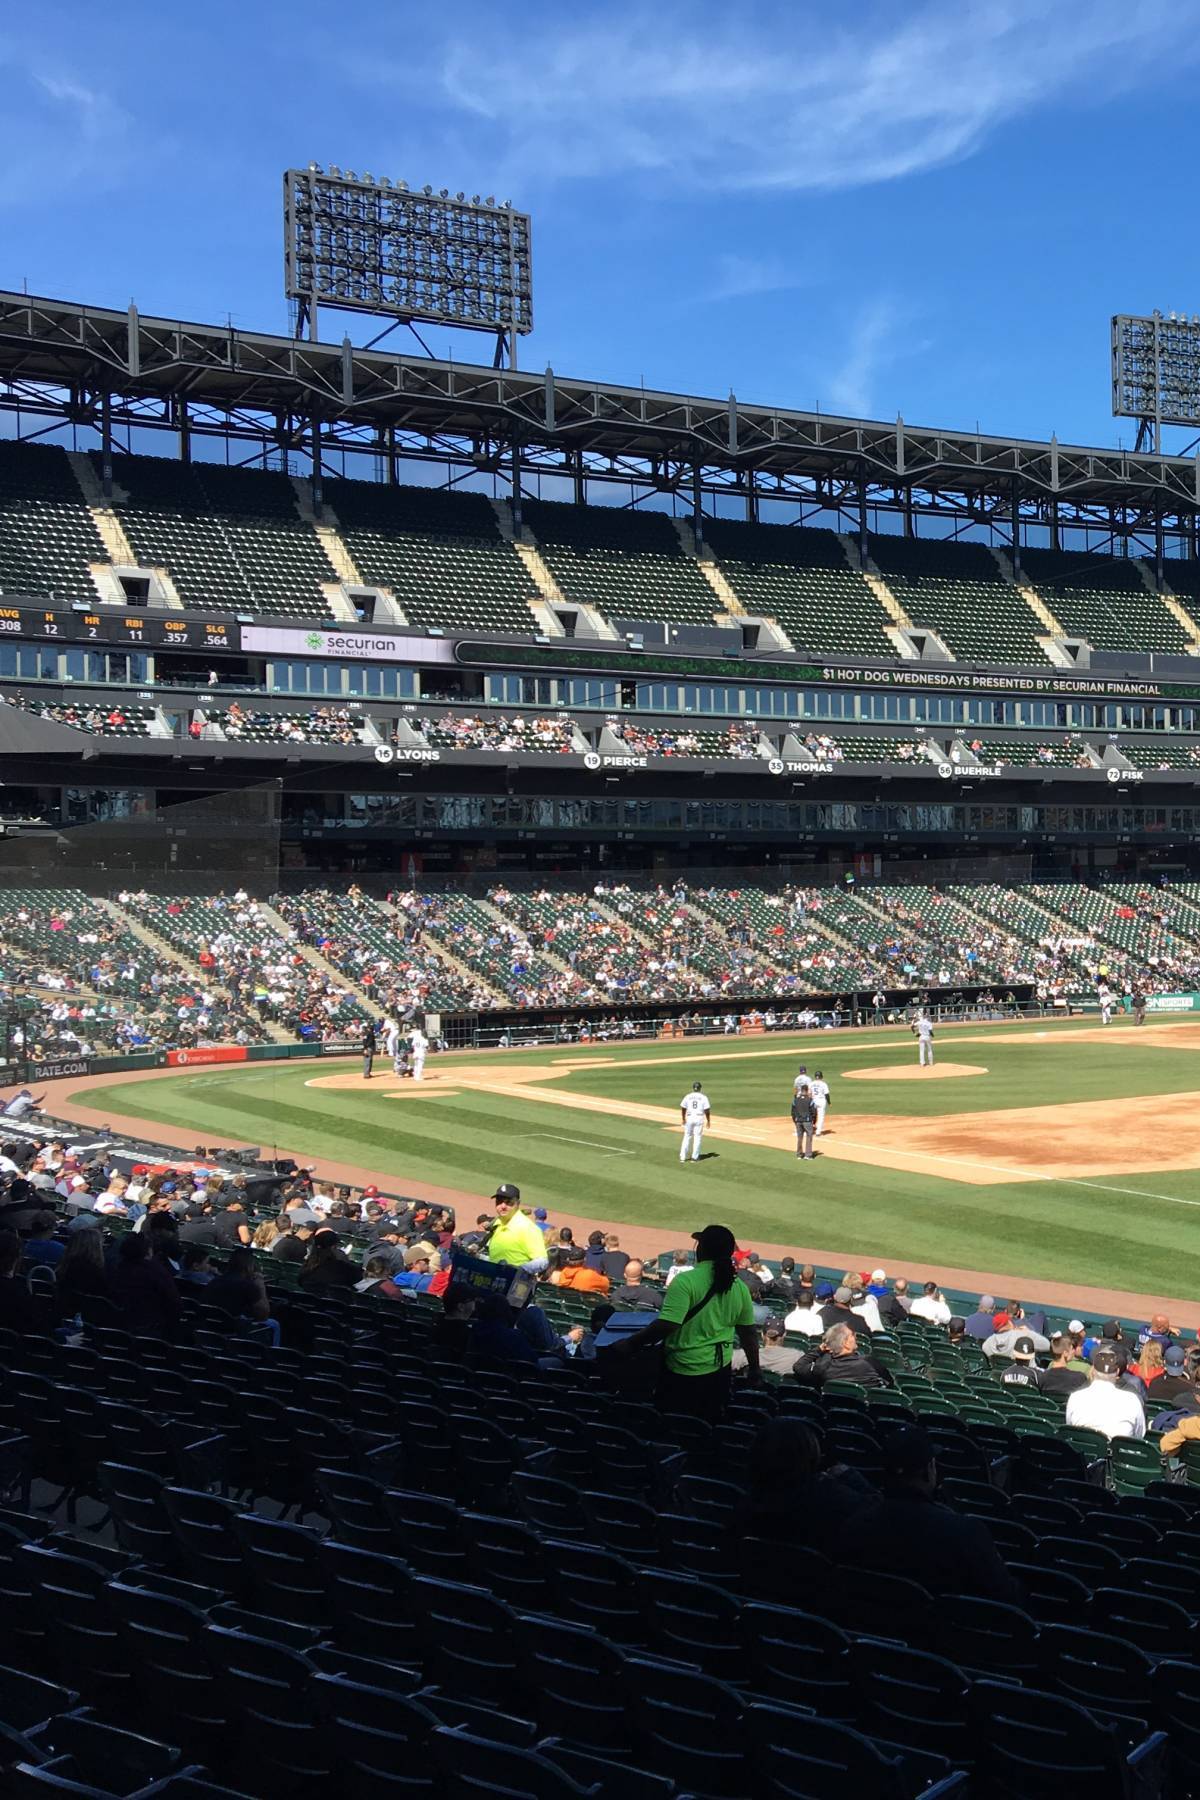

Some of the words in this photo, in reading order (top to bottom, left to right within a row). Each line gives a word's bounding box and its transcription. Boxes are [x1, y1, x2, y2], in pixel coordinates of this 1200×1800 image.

[0, 610, 19, 619] AVG
[45, 613, 54, 622] H
[85, 616, 100, 625] HR
[125, 619, 143, 628] RBI
[165, 622, 186, 631] OBP
[206, 625, 226, 634] SLG
[44, 624, 58, 635] 12
[89, 628, 97, 637] 2
[129, 630, 143, 640] 11
[163, 633, 188, 643] .357
[203, 636, 228, 646] .564
[327, 635, 396, 650] securian
[823, 668, 834, 680] $1
[838, 669, 861, 681] HOT
[864, 672, 889, 682] DOG
[893, 674, 970, 686] WEDNESDAYS
[973, 677, 1034, 689] PRESENTED
[1037, 680, 1051, 690] BY
[1053, 681, 1105, 692] SECURIAN
[1107, 684, 1161, 695] FINANCIAL
[397, 750, 440, 761] LYONS
[603, 757, 648, 767] PIERCE
[787, 762, 833, 773] THOMAS
[954, 766, 1001, 776] BUEHRLE
[1122, 771, 1144, 780] FISK
[34, 1062, 88, 1079] RATE.COM
